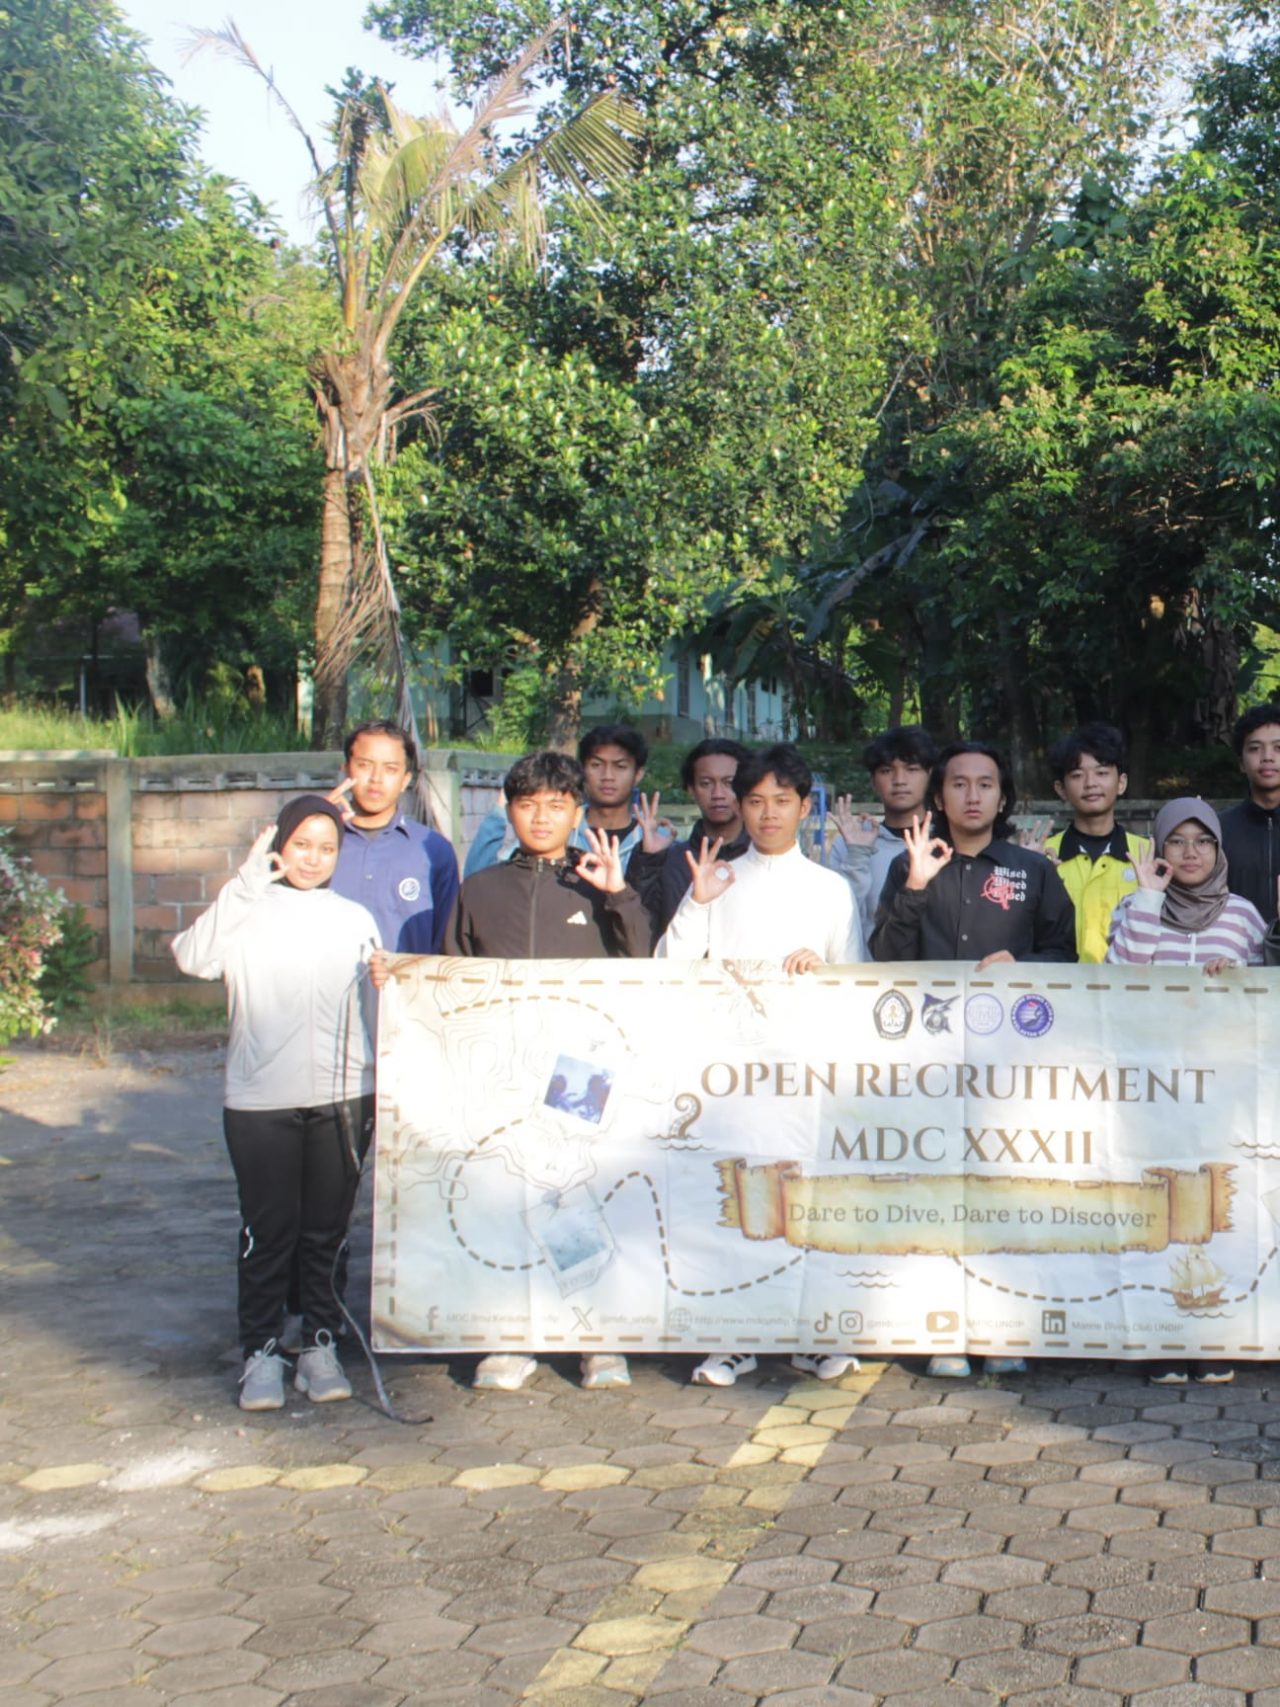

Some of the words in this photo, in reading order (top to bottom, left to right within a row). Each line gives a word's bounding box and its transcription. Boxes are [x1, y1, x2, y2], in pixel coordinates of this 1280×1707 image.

[701, 1062, 837, 1098] OPEN
[854, 1062, 1216, 1104] RECRUITMENT
[831, 1126, 947, 1162] MDC
[963, 1127, 1095, 1164] XXXII
[789, 1203, 846, 1222] Dare
[853, 1205, 879, 1223] to
[887, 1204, 946, 1224] Dive,
[953, 1204, 1010, 1223] Dare
[1018, 1206, 1044, 1224] to
[1051, 1206, 1157, 1228] Discover
